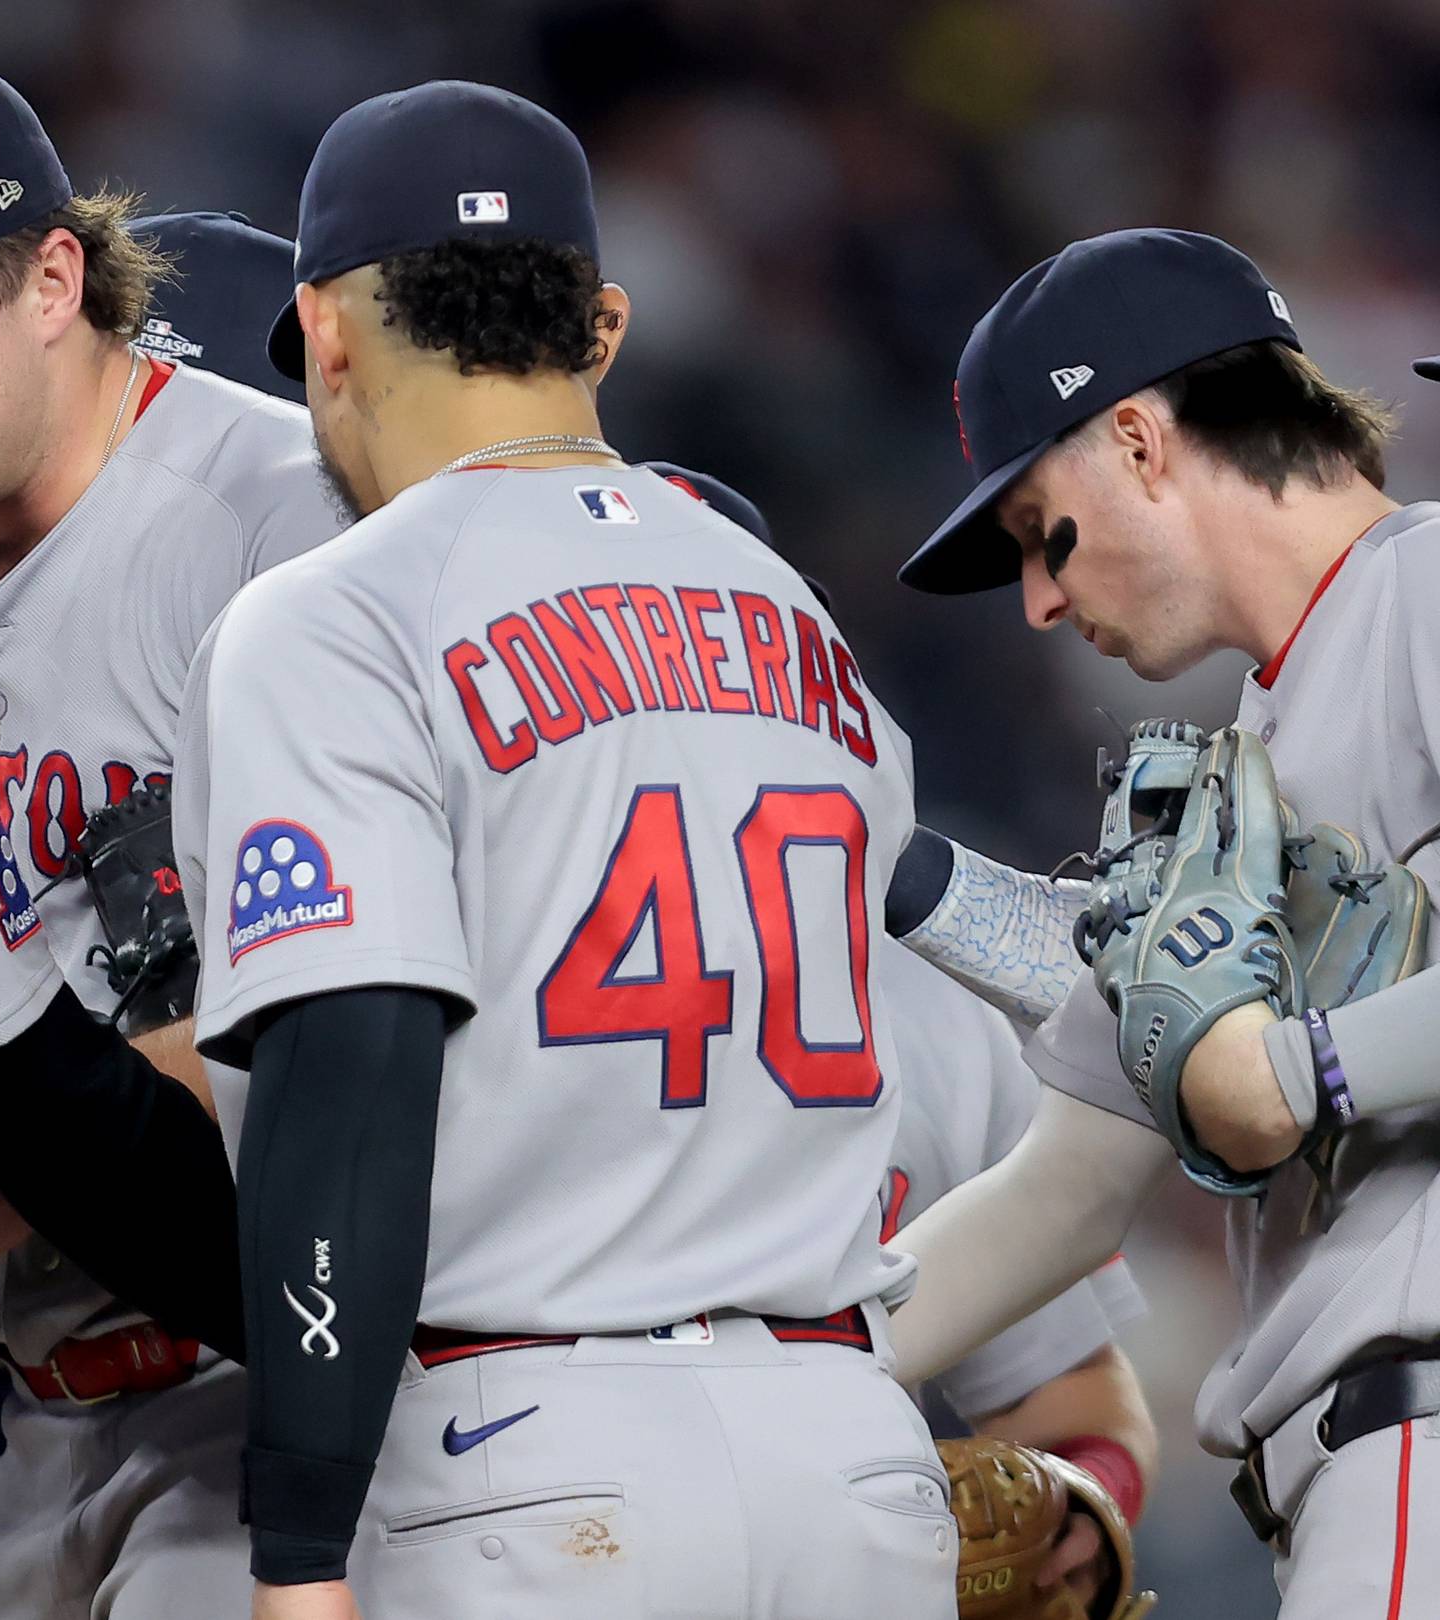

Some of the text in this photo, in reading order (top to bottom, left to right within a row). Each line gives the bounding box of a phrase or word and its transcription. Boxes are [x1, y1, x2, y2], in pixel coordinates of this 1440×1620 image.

[139, 332, 204, 358] TSEASON
[444, 582, 878, 775] CONTRERAS
[535, 783, 884, 1109] 40
[1133, 1012, 1168, 1109] ilson
